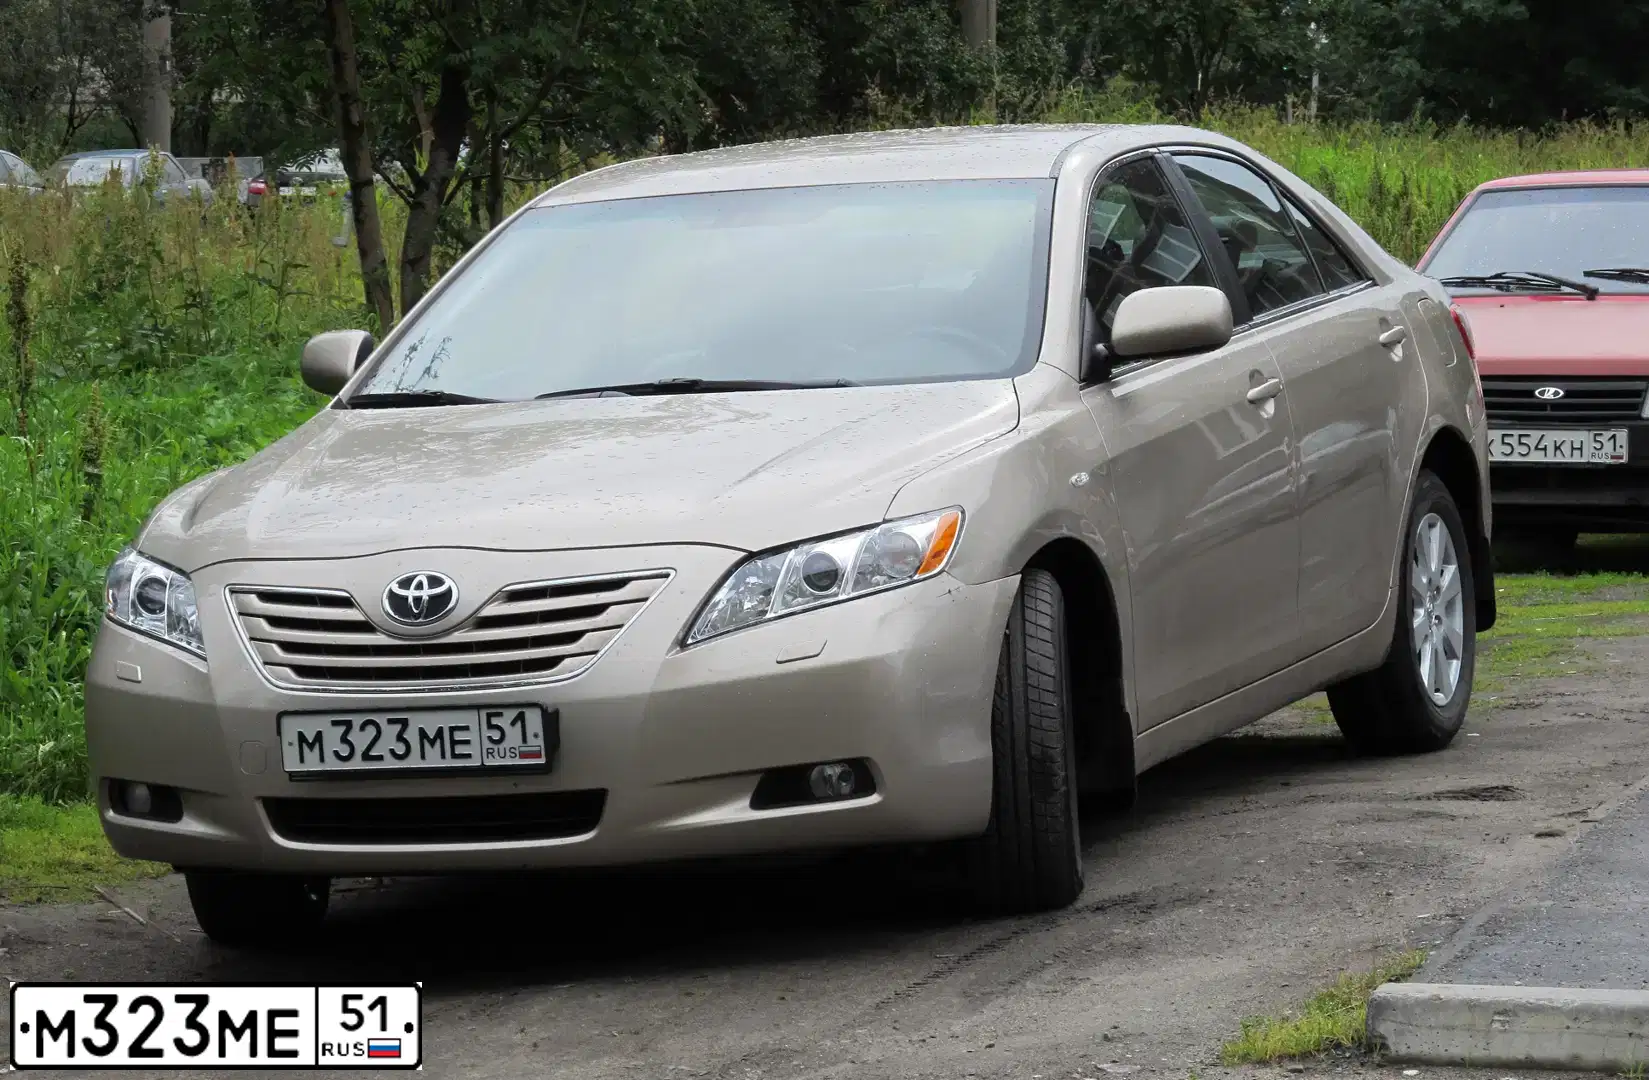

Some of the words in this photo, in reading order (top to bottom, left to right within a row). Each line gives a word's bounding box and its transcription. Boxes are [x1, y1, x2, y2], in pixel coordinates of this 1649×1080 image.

[1593, 432, 1617, 452] 51
[1590, 452, 1610, 460] RUS
[485, 710, 528, 745] 51
[486, 746, 518, 760] RUS
